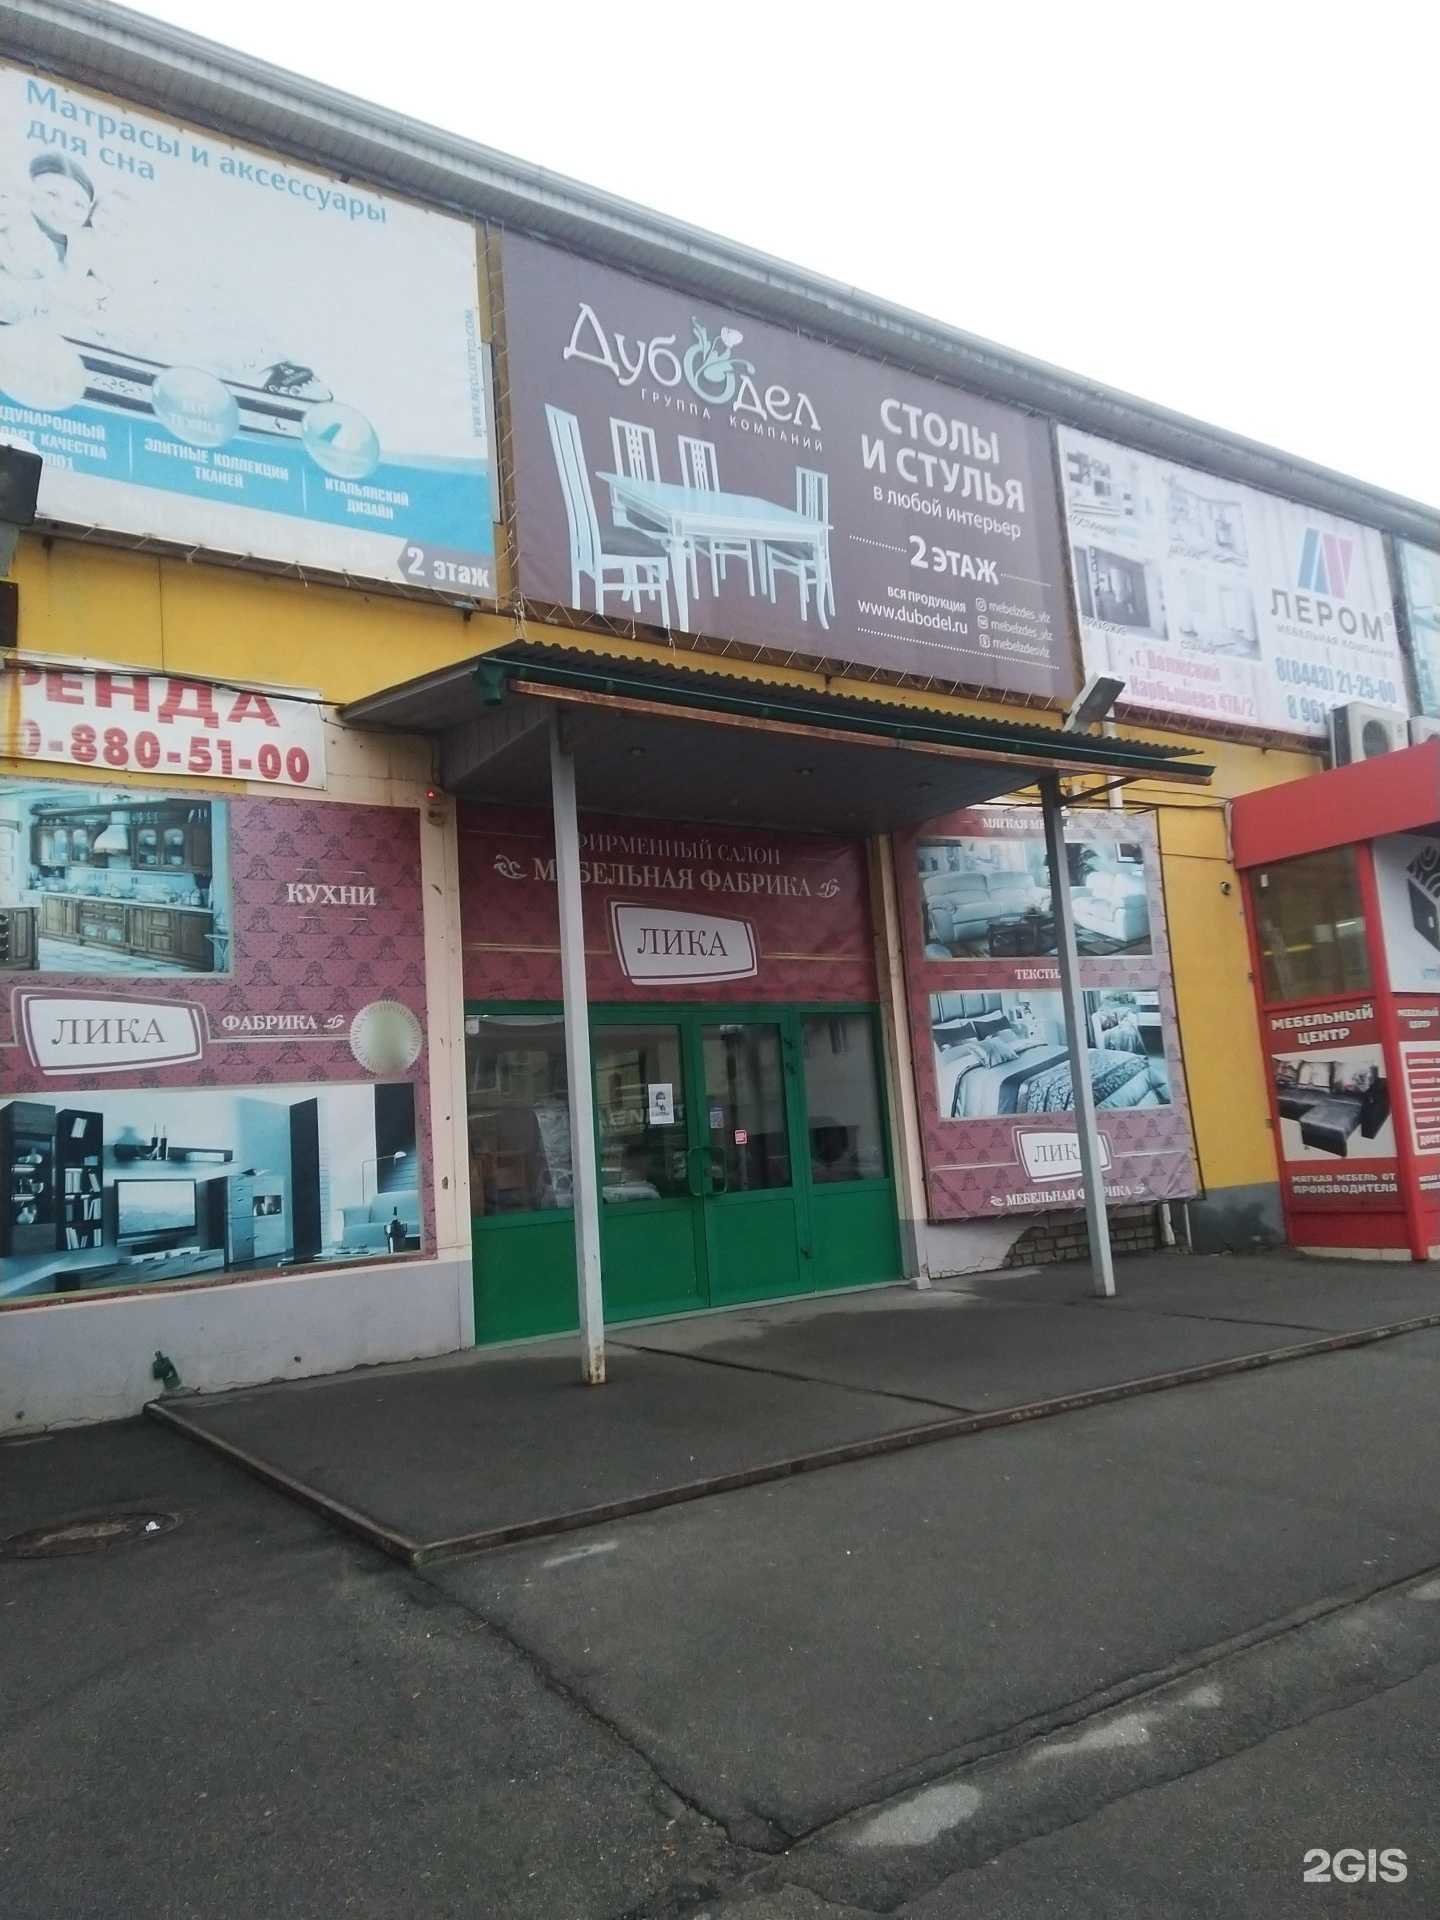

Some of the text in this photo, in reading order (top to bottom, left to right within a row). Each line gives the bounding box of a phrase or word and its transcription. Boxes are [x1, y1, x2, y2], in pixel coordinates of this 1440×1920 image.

[26, 117, 156, 182] для сна
[27, 79, 387, 224] Матрасы и аксессуары
[641, 387, 712, 419] ГРУППА
[880, 398, 1000, 465] СТОЛЫ
[144, 438, 289, 481] ЭЛИТНЫЕ КОЛЛЕКЦИИ
[861, 433, 1025, 513] И СТУЛЬЯ
[195, 466, 245, 488] ТКАНЕЙ
[325, 477, 410, 507] ИТАЛЬЯНСКИЙ
[346, 498, 395, 520] ДИЗАЙН
[888, 490, 943, 518] любой
[946, 508, 1022, 542] интерьер
[407, 548, 490, 589] 2 этаж
[909, 534, 999, 585] 2 ЭТАЖ
[887, 585, 967, 613] ВСЯ ПРОДУКЦИЯ
[857, 600, 968, 635] www.dubodel.ru
[1270, 588, 1385, 642] ЛЕРОМ
[717, 844, 781, 866] САЛОН
[533, 857, 812, 897] МБЕЛЬНАЯ ФАБРИКА
[286, 883, 377, 907] КУХНИ
[637, 926, 729, 957] ЛИКА
[1015, 968, 1061, 981] ТЕКСТИ
[51, 1017, 168, 1045] ЛИКА
[222, 1014, 318, 1032] ФАБРИКА
[1272, 1003, 1374, 1032] МЕБЕЛЬНЫЙ
[1297, 1028, 1351, 1046] ЦЕНТР
[1034, 1143, 1080, 1163] ЛИК
[1293, 1183, 1398, 1195] ПРОИЗВОДИТЕЛЯ
[1336, 1173, 1378, 1182] МЕБЕЛЬ
[1382, 1172, 1396, 1181] ОТ
[1006, 1186, 1132, 1207] МЕБЕЛЬНАЯ ФРИКА
